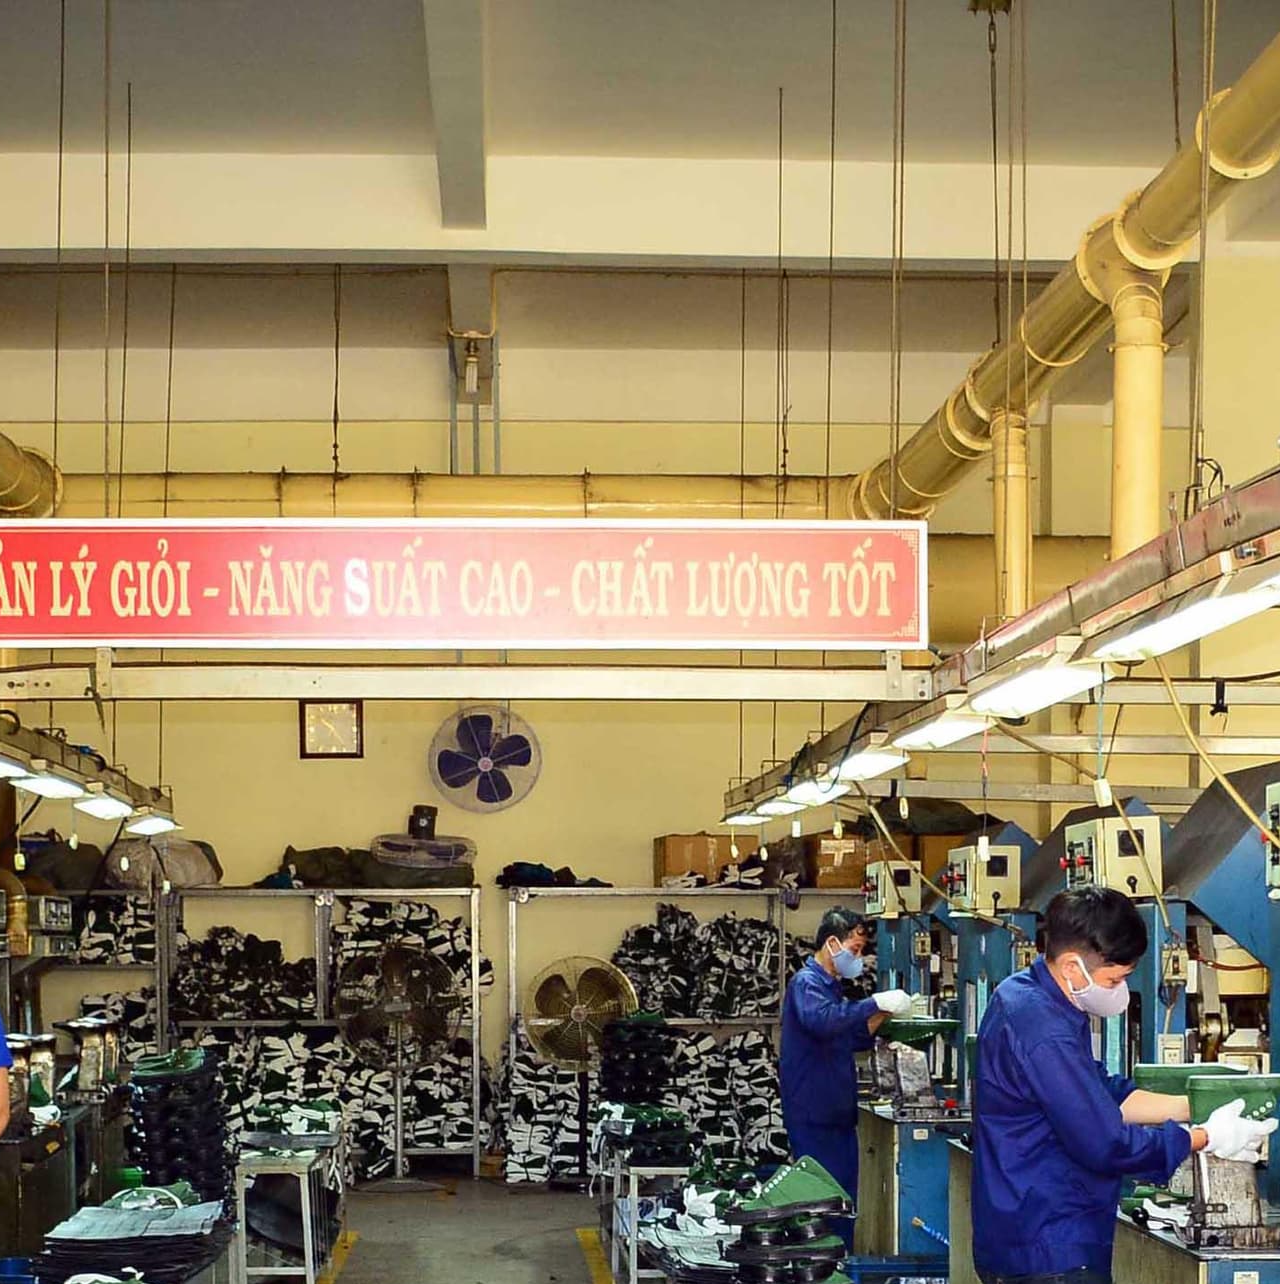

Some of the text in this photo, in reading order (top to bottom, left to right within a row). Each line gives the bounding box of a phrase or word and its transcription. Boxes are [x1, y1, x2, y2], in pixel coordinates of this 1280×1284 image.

[49, 544, 97, 617] LÝ
[110, 538, 192, 617] GIỎI
[228, 545, 334, 617] NĂNG
[344, 536, 448, 617] SUẤT
[459, 558, 534, 617] CAO
[571, 536, 674, 618] CHẤT
[686, 551, 811, 628] LƯỢNG
[822, 536, 896, 618] TỐT
